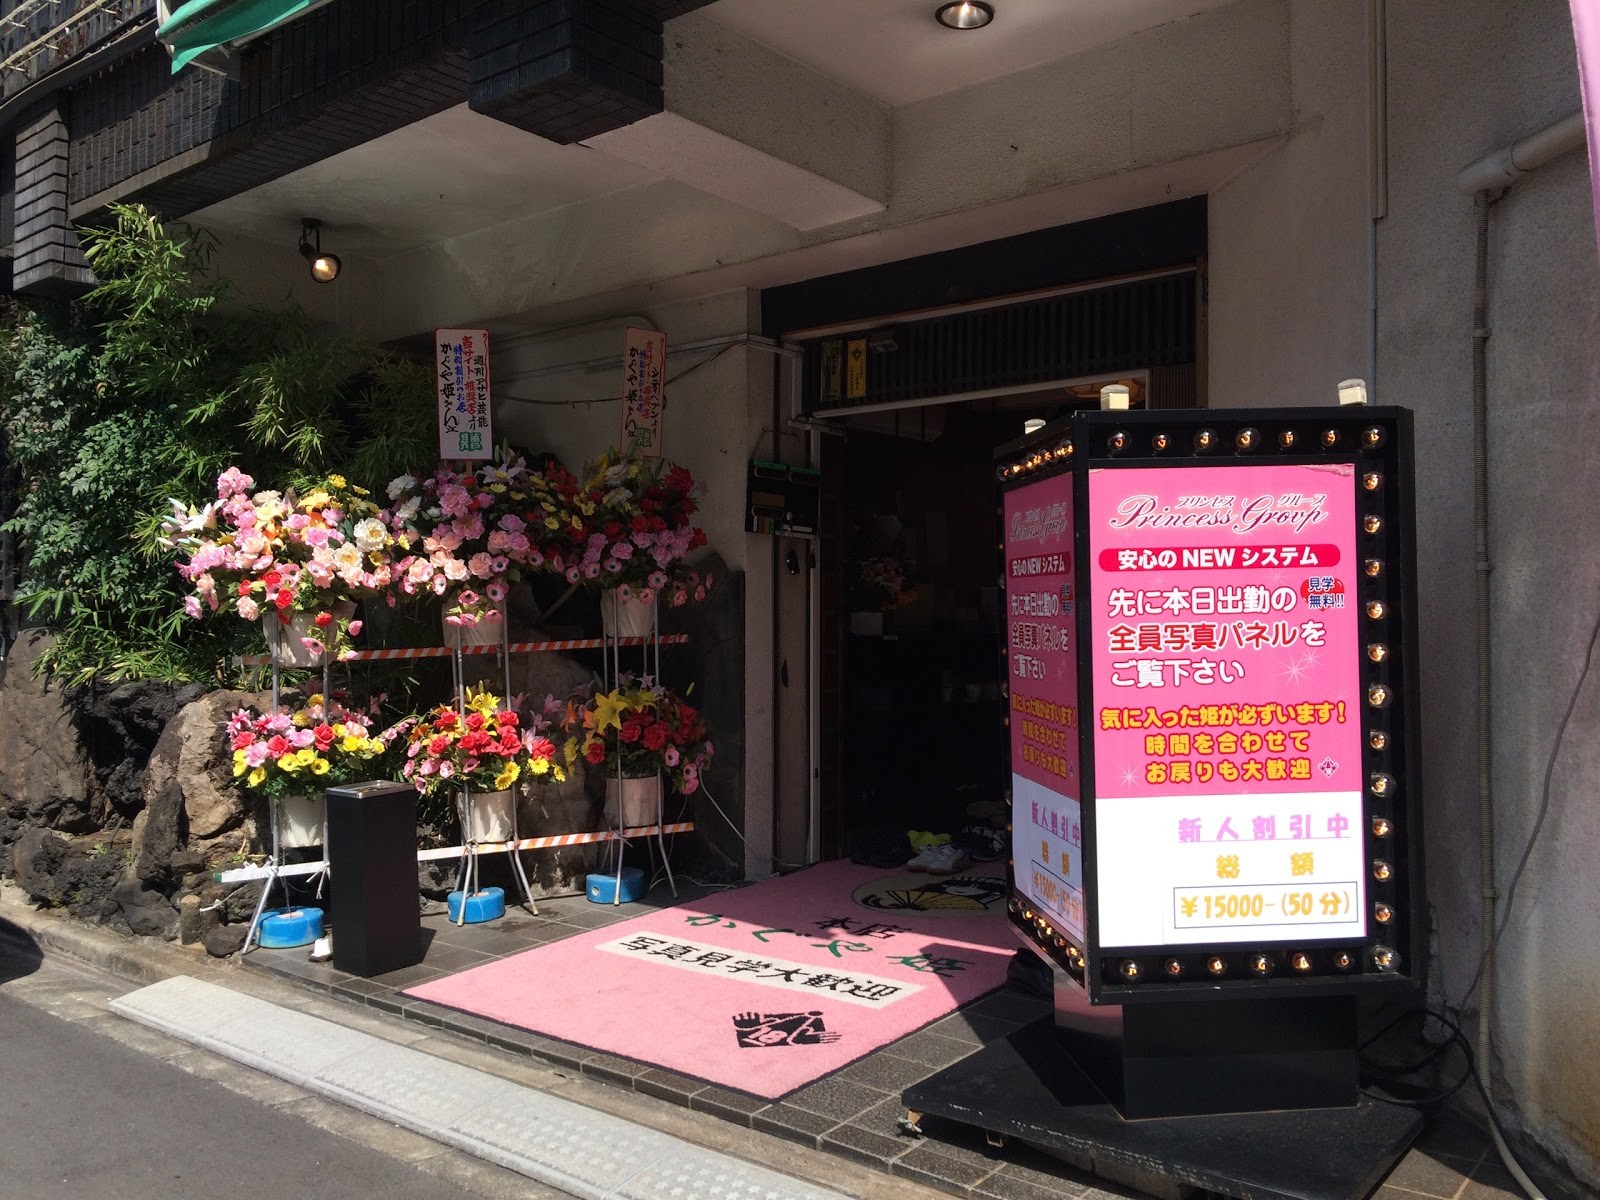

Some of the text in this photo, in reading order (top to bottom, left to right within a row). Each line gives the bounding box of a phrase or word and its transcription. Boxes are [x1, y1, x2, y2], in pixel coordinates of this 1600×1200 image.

[1110, 495, 1328, 533] Princess Group
[1118, 546, 1319, 570] 安心の NEW システム
[1309, 577, 1335, 591] 見学
[1108, 586, 1297, 617] 先に本日出勤の
[1108, 620, 1326, 653] 全員写真パネルを
[1110, 658, 1245, 688] ご覧下さい
[1101, 701, 1347, 730] 気に入った姫が必ずいます!
[1145, 730, 1310, 756] 時間を合わせて
[1145, 759, 1312, 784] お戻りも大歓迎
[1178, 813, 1349, 842] 新人割引中
[618, 936, 903, 1002] 写真見学大歓迎
